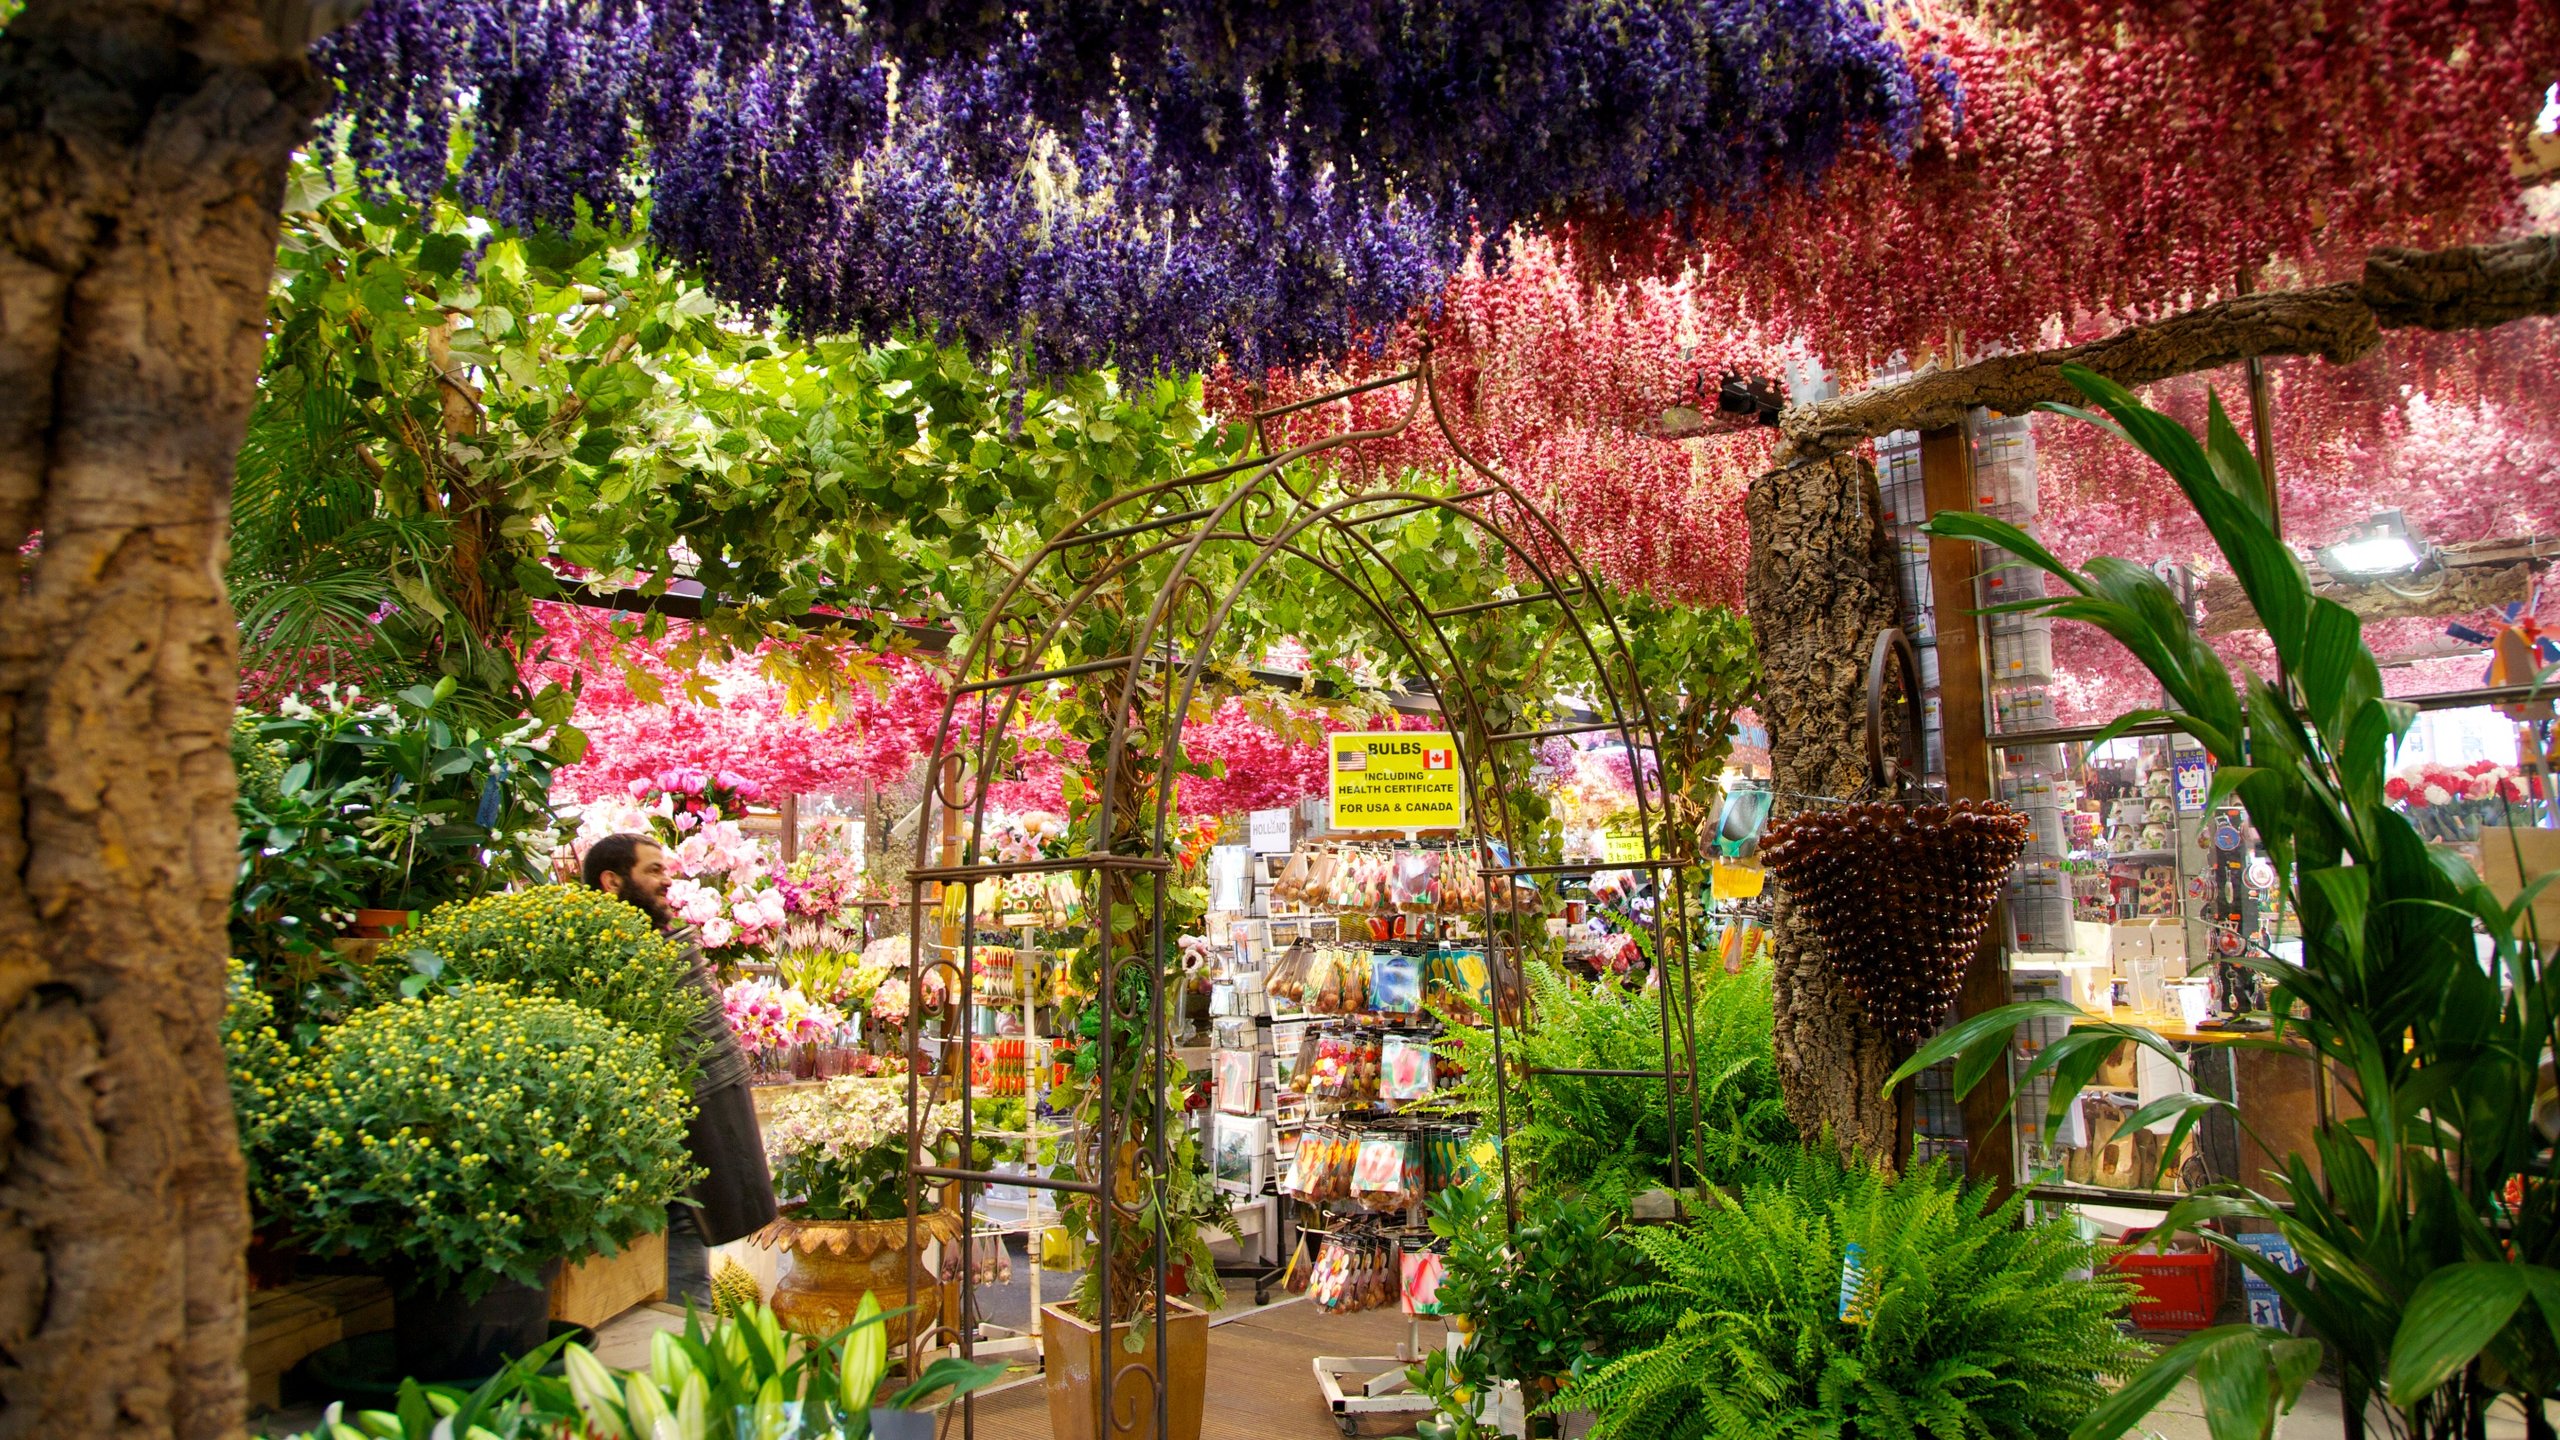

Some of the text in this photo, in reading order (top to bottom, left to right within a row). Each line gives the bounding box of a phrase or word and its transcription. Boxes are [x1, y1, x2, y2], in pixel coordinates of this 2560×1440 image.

[1368, 742, 1421, 755] BULBS
[1365, 771, 1424, 780] INCLUDING
[1338, 783, 1454, 794] HEALTH CERTIFICATE
[1340, 802, 1453, 813] FOR USA & CANADA
[1252, 821, 1287, 835] HOLLAND
